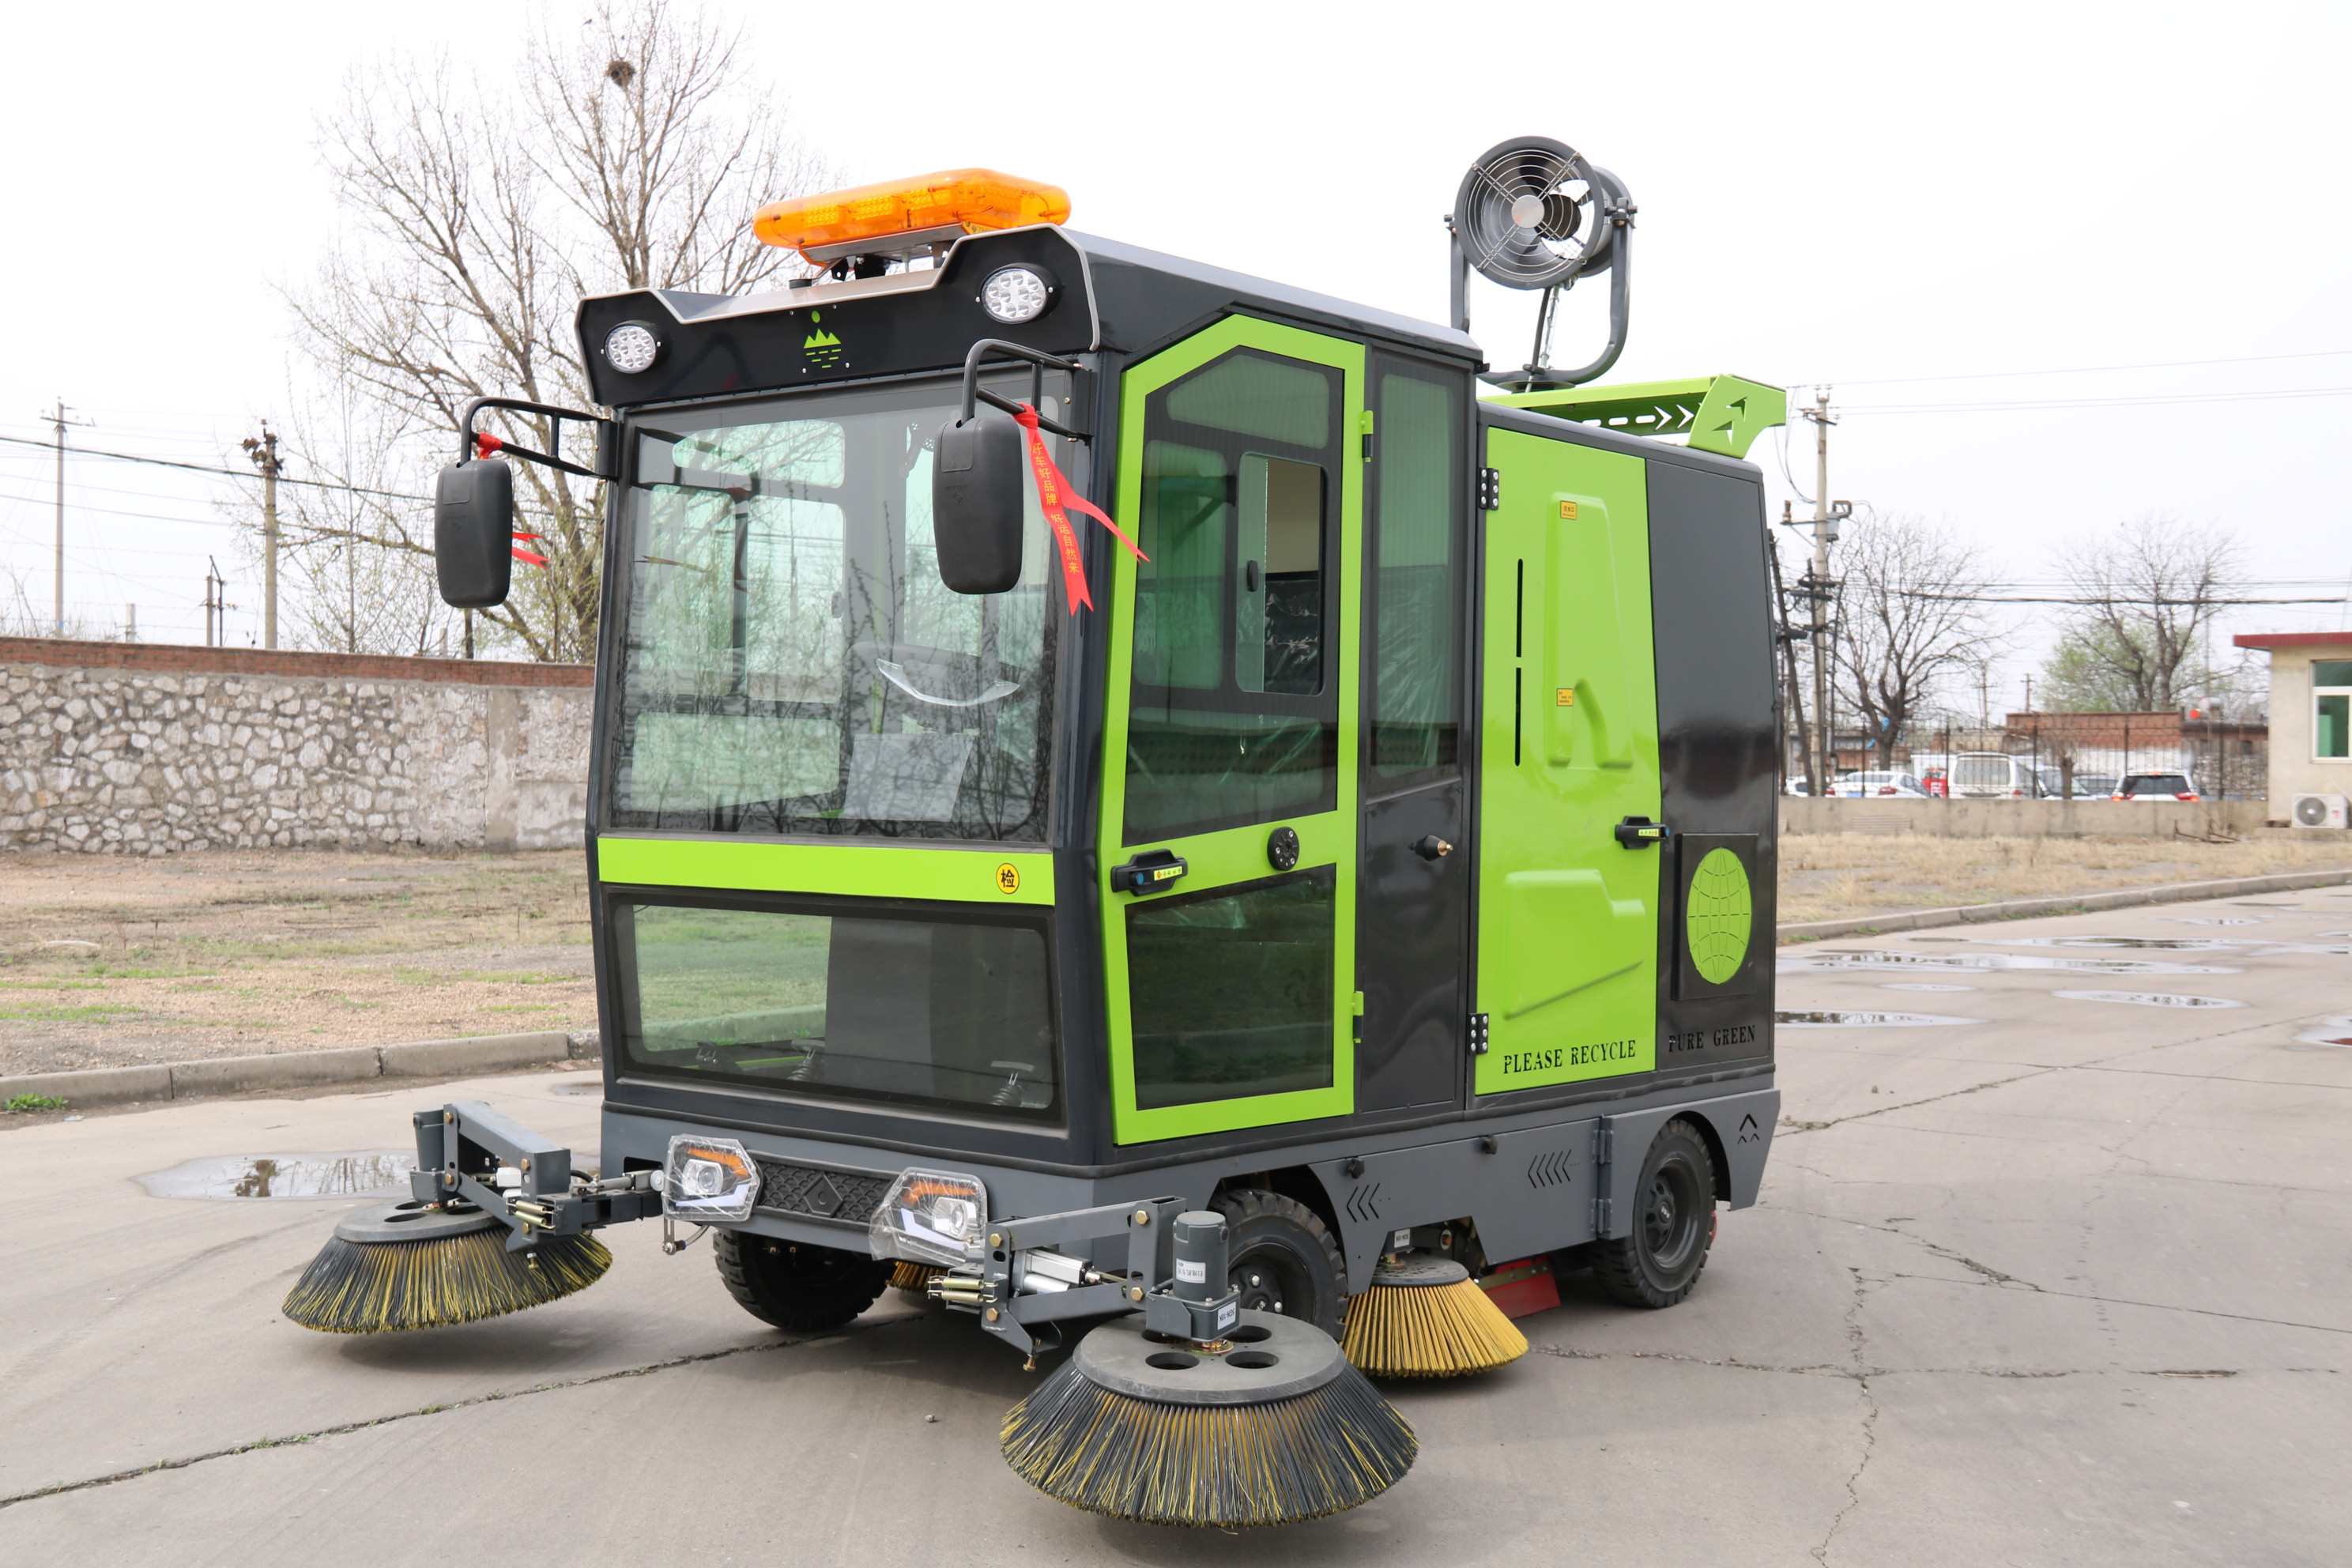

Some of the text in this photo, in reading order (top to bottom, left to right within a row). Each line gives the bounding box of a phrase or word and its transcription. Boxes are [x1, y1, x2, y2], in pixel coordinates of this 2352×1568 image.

[1031, 442, 1080, 574] 好车好品牌 好运自然来
[1503, 1039, 1636, 1074] PLEASE RECYCLE
[1668, 1025, 1755, 1053] PURE GREEN
